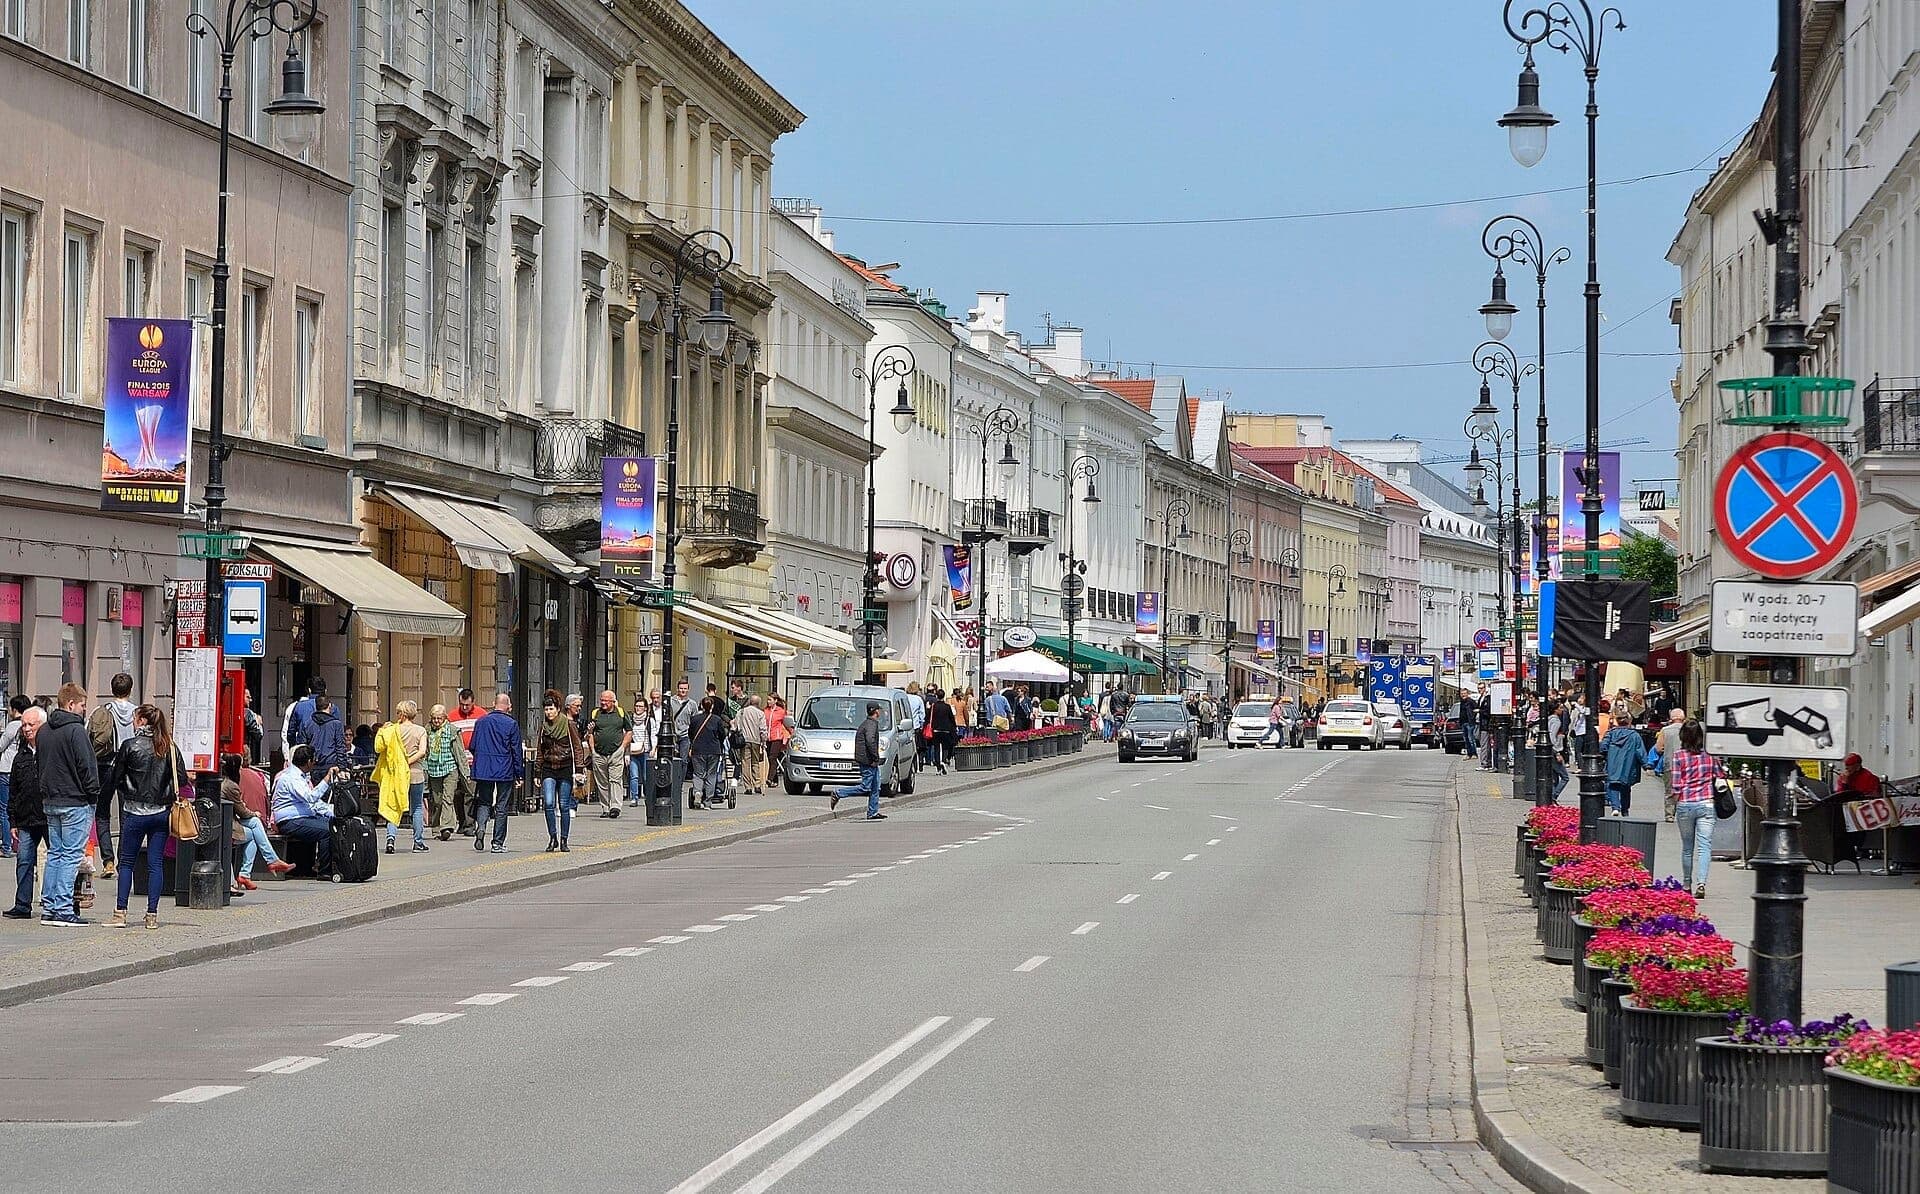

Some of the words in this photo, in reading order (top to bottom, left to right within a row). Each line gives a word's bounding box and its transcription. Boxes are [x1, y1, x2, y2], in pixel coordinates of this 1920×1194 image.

[132, 359, 168, 369] EUROPA
[127, 381, 151, 389] FINAL
[152, 382, 170, 390] 2015
[128, 388, 170, 398] WARSAW
[107, 487, 150, 496] WESTERN
[120, 494, 150, 502] UNION
[1640, 492, 1664, 509] H&M
[227, 564, 263, 577] FOKSAL
[263, 565, 272, 576] 01
[179, 583, 190, 596] E-2
[1742, 592, 1755, 603] W
[1758, 593, 1791, 607] godz.
[1796, 594, 1826, 606] 20-7
[1750, 611, 1768, 623] nie
[1772, 612, 1819, 626] dotyczy
[1742, 630, 1824, 642] zaopatrzenia
